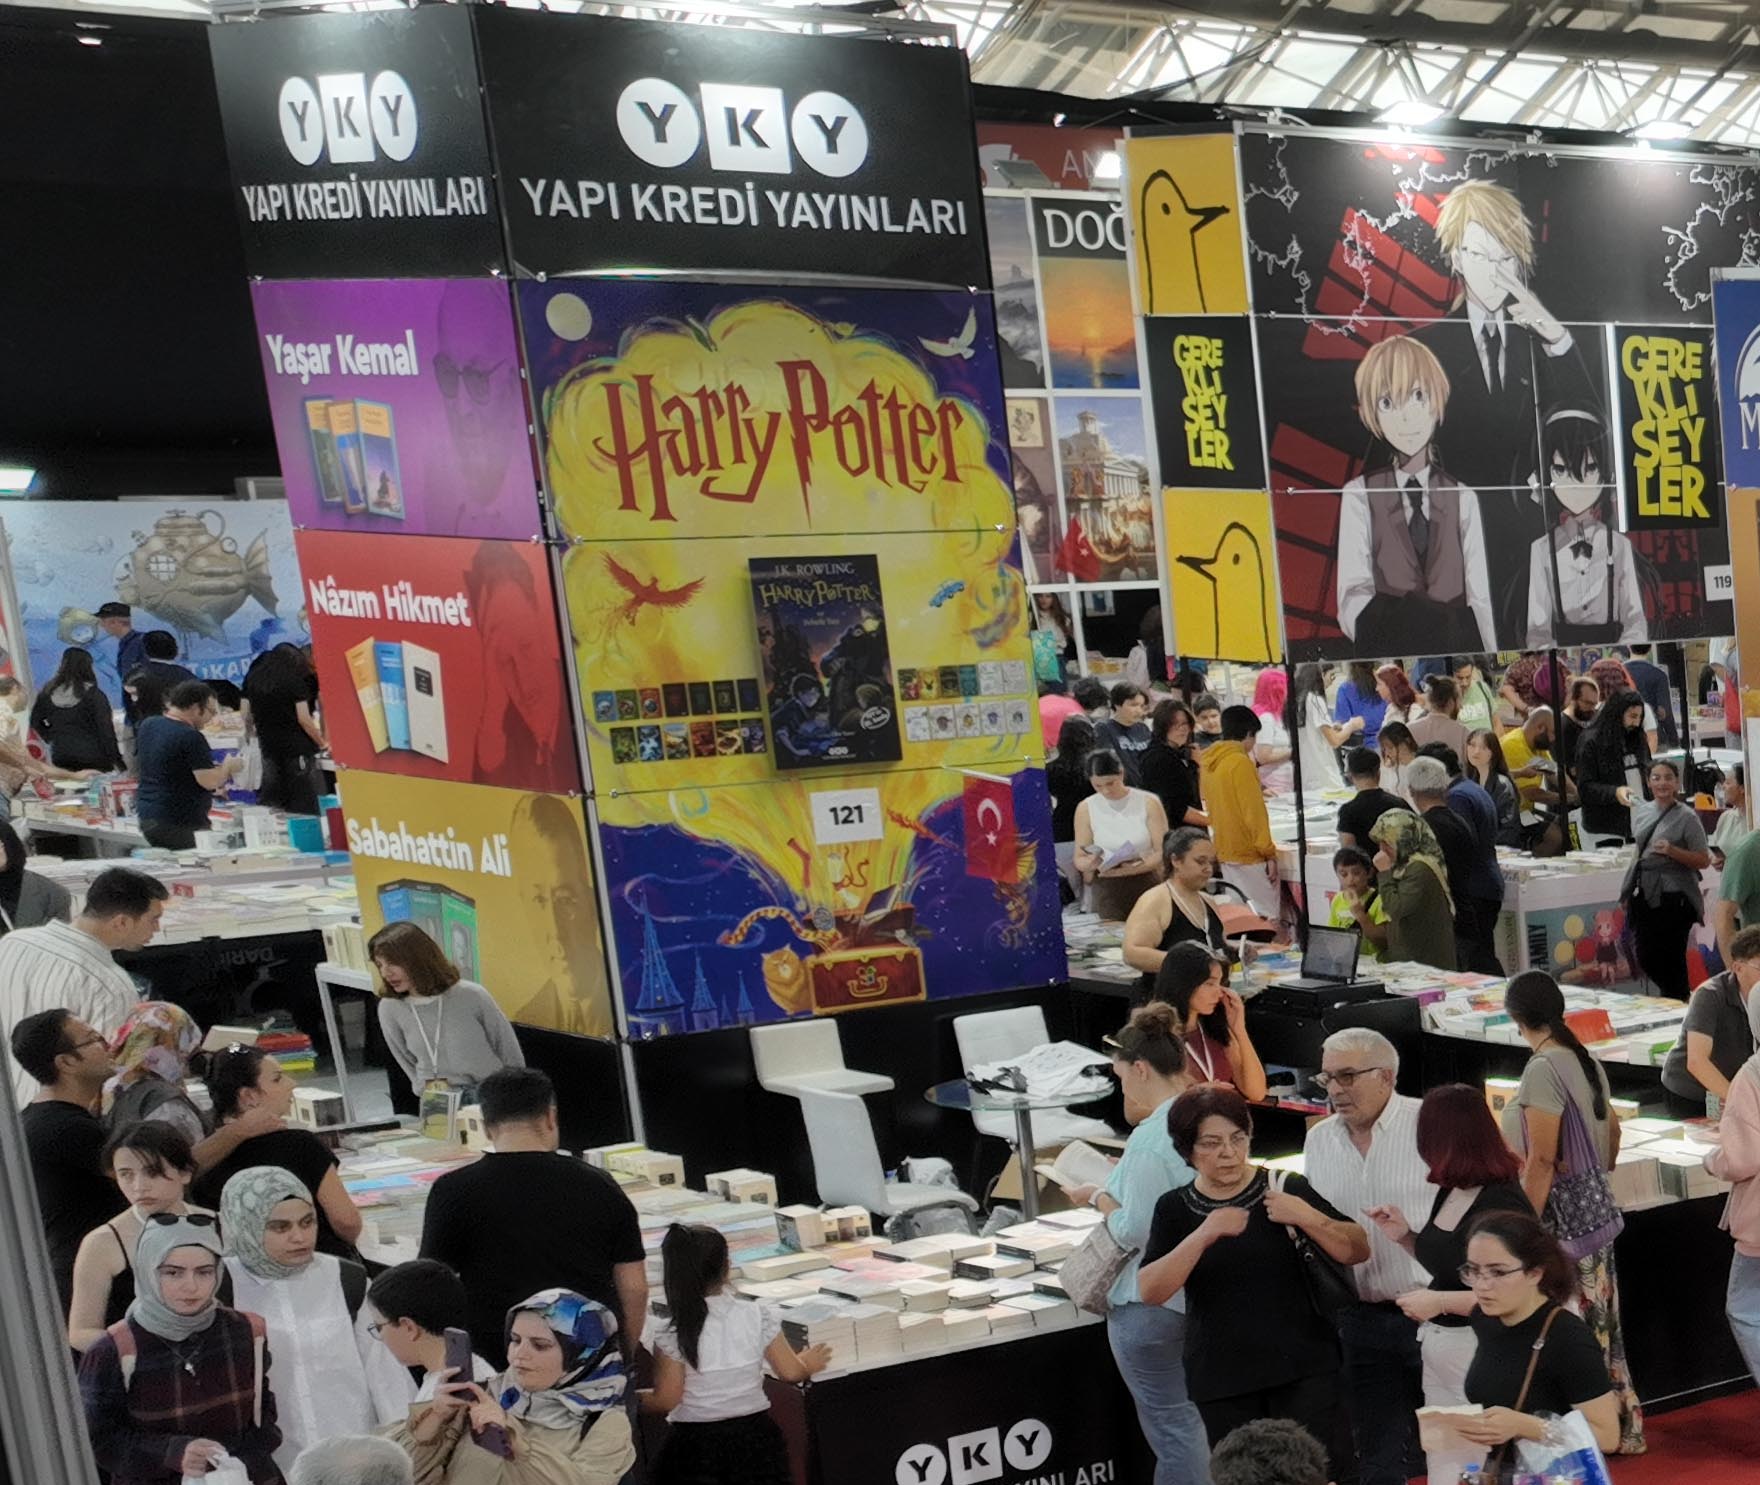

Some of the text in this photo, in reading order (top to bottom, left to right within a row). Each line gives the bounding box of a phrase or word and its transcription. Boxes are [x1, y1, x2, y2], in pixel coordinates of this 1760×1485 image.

[242, 172, 487, 221] YAPI KREDİ YAYINLARI
[520, 177, 967, 235] YAPI KREDİ YAYINLARI
[266, 329, 418, 384] Yaşar Kemal
[1173, 334, 1224, 368] GERE
[1622, 335, 1702, 382] GERE
[594, 360, 964, 529] Harry Potter
[1188, 429, 1234, 471] LER
[1637, 464, 1711, 519] LER
[796, 561, 855, 577] ROWLING
[1713, 575, 1732, 589] 119
[309, 575, 472, 627] Nâzım Hikmet
[759, 580, 876, 608] HARRY POTTER
[829, 804, 865, 826] 121
[348, 818, 512, 878] Sabahattin Ali
